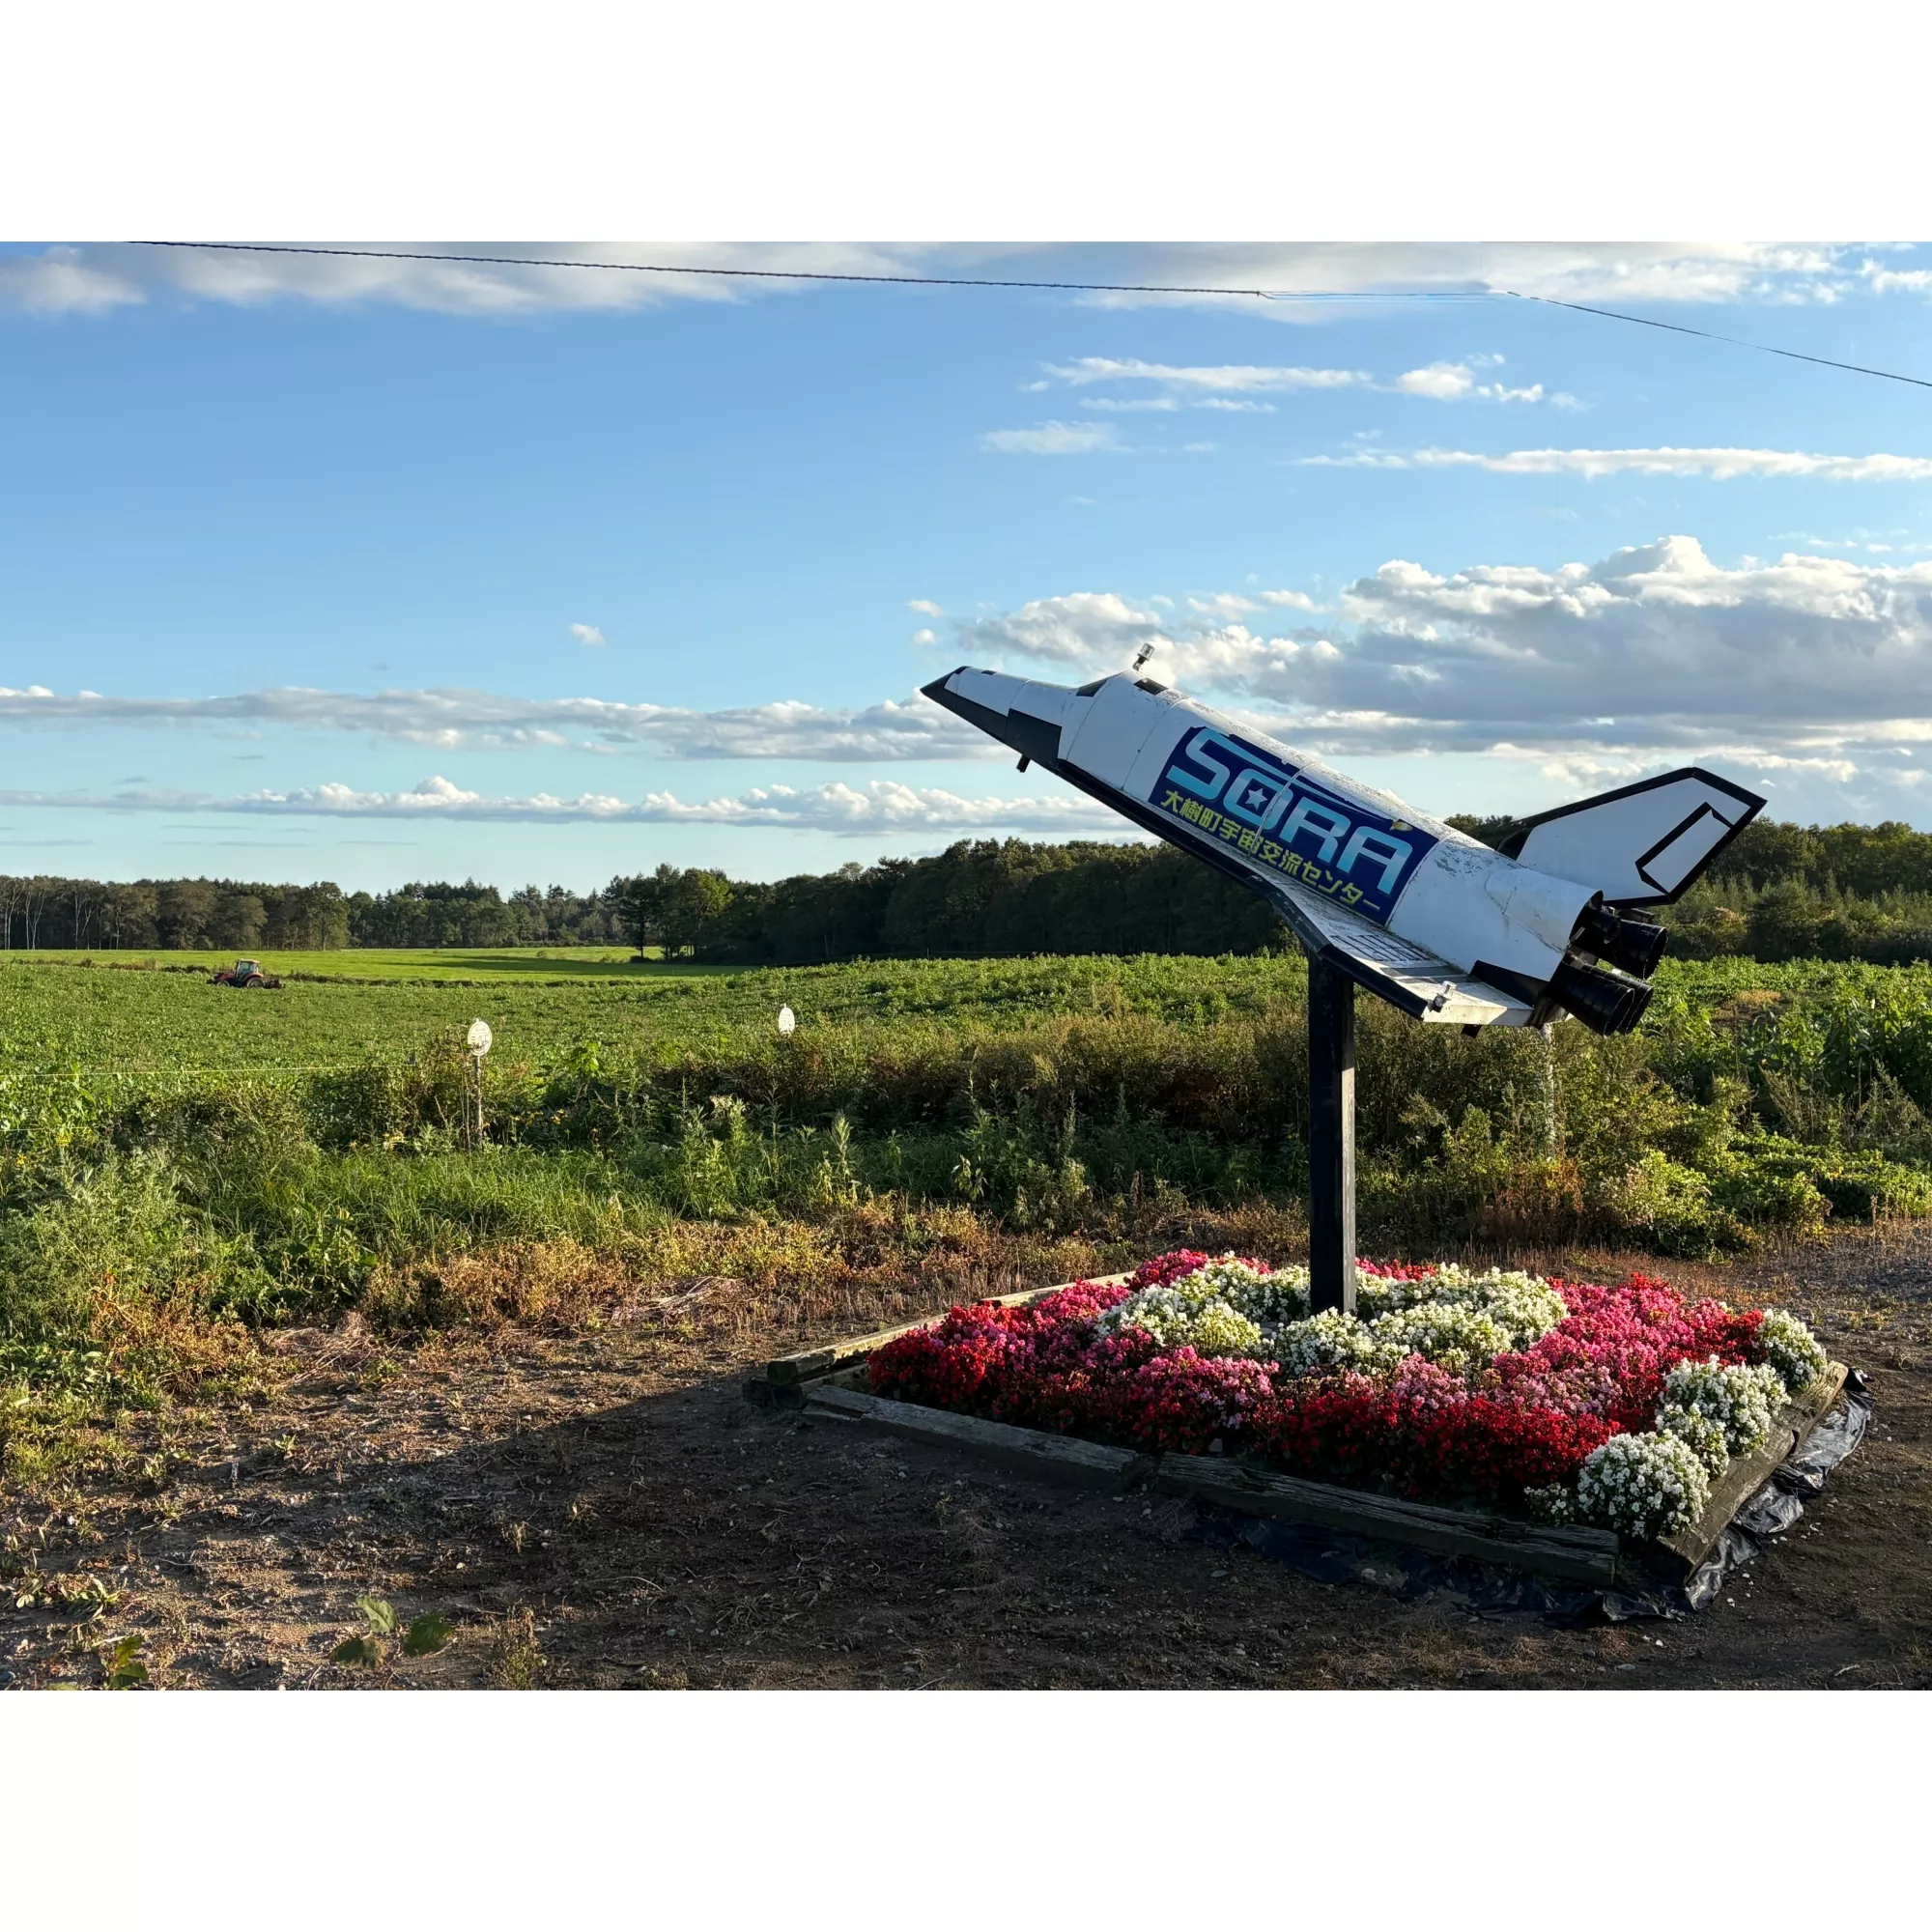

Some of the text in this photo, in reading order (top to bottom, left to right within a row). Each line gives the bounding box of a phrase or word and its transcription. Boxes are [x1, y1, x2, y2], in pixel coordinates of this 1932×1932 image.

[1160, 789, 1380, 911] 大樹町宇宙交流センター
[1166, 728, 1412, 895] SORA
